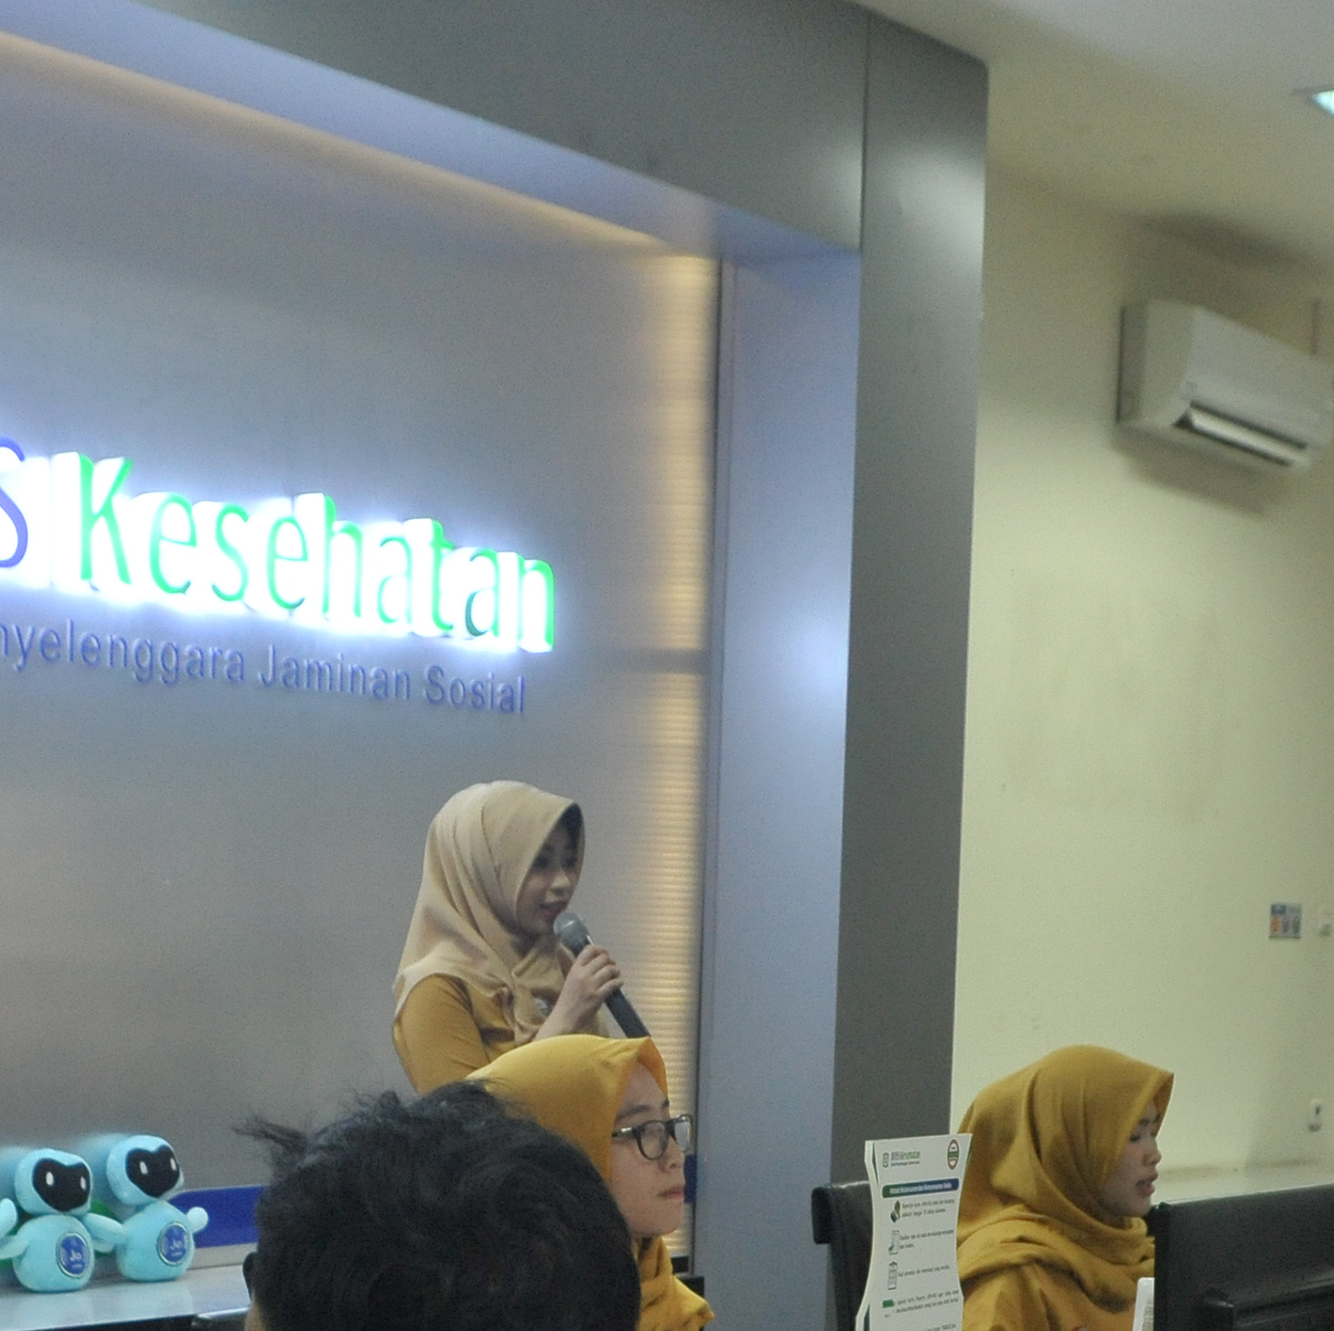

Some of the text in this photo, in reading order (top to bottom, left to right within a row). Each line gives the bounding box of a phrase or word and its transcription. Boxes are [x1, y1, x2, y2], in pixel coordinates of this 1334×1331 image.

[75, 451, 556, 652] Kesehatan
[258, 645, 413, 703] Jaminan
[422, 664, 527, 716] Sosial
